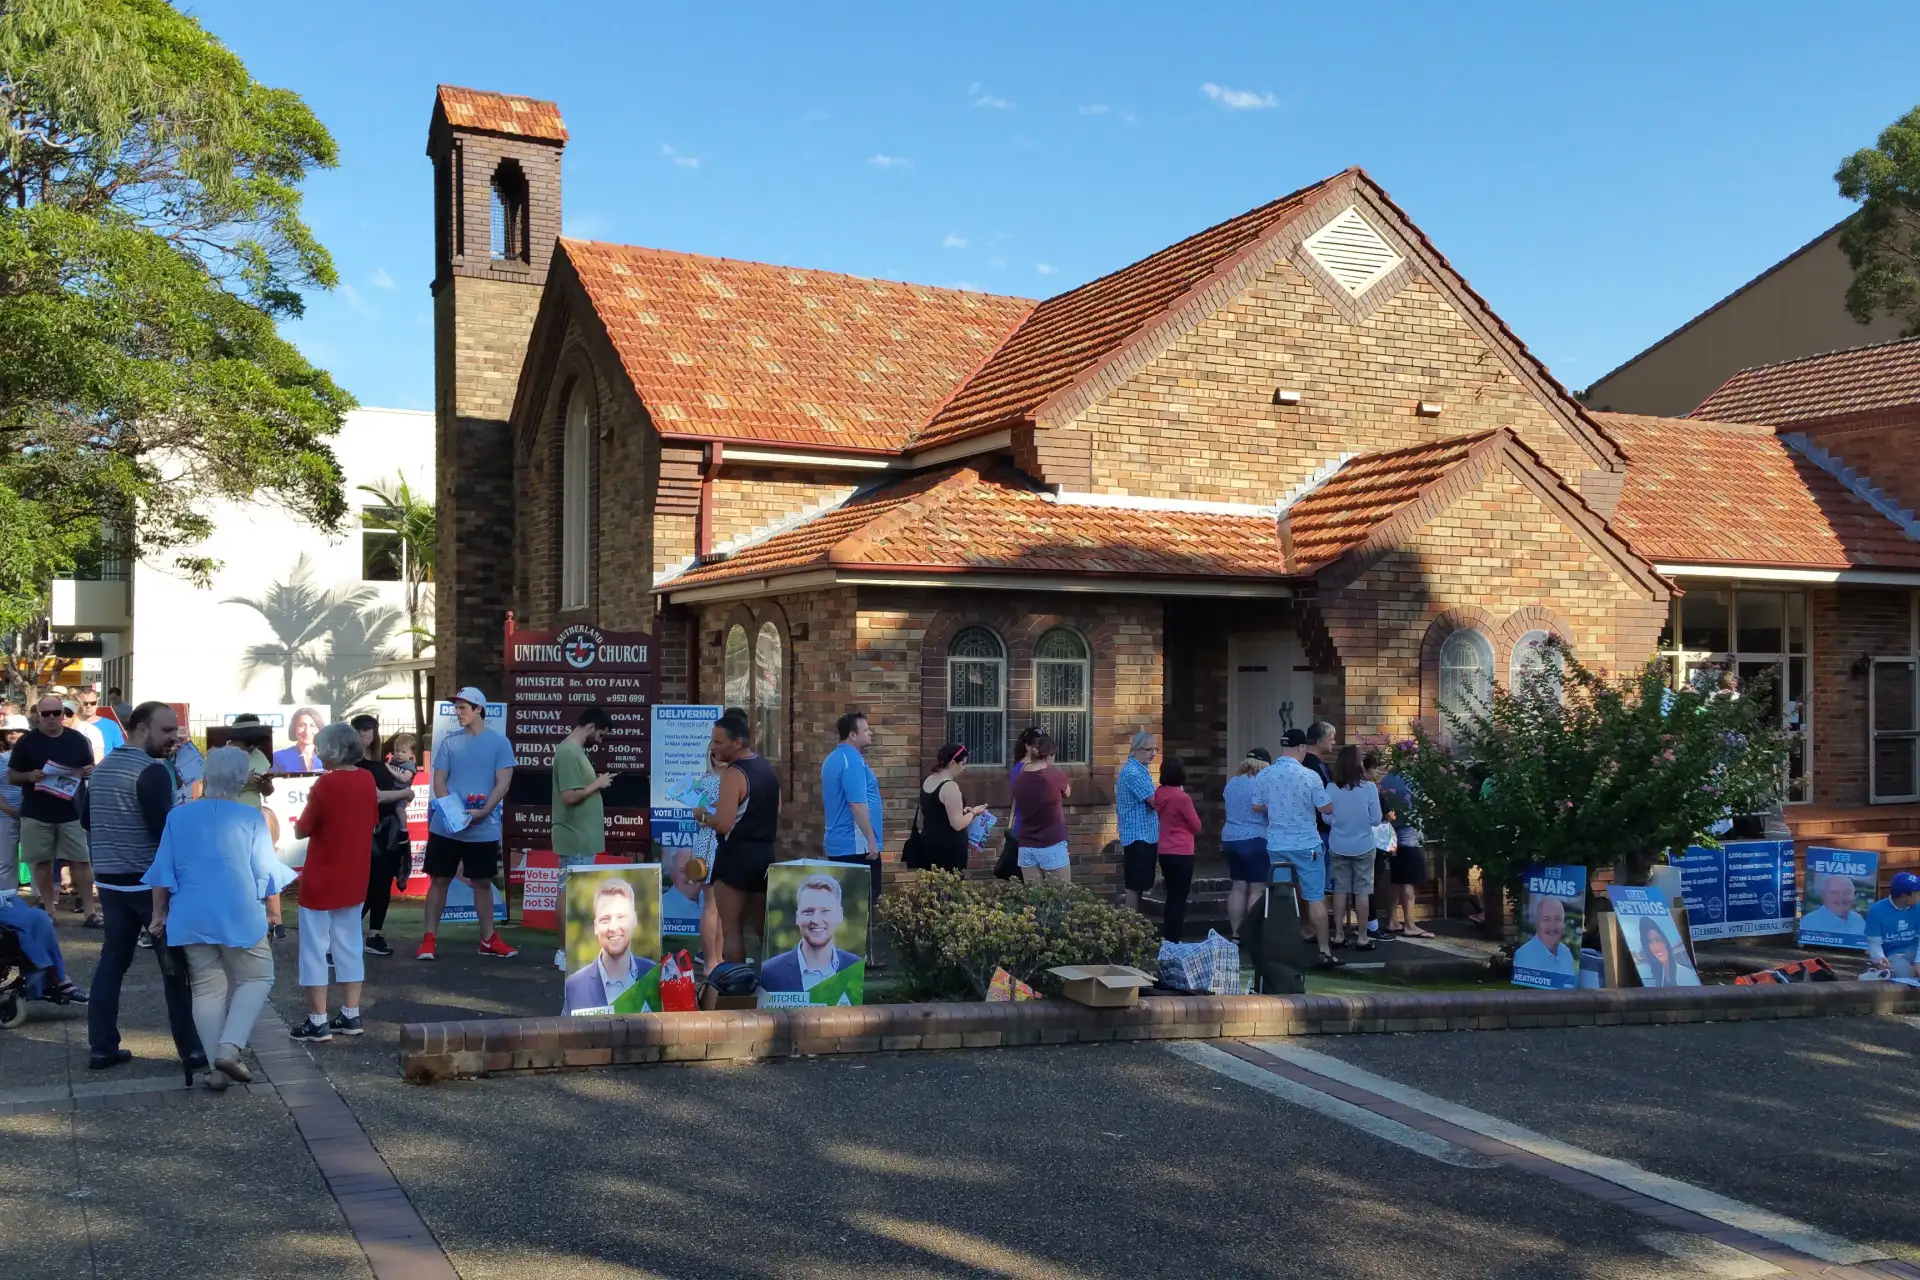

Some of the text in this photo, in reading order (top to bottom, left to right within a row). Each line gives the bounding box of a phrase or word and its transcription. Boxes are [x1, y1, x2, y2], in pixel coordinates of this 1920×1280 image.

[556, 624, 603, 644] SUTHERLAND
[514, 644, 648, 662] UNITING CHURCH
[516, 677, 564, 687] MINISTER
[586, 679, 606, 687] OTO
[610, 679, 640, 687] FAIVA
[516, 693, 562, 701] SUTHERLAND
[568, 694, 596, 702] LOFTUS
[516, 710, 562, 720] SUNDAY
[659, 710, 716, 719] DELIVERING
[516, 725, 572, 735] SERVICES
[516, 743, 557, 753] FRIDAY
[515, 813, 527, 822] We
[528, 813, 543, 822] Are
[614, 815, 644, 825] Church
[1816, 860, 1866, 874] EVANS
[526, 870, 549, 879] Vote
[1547, 868, 1560, 878] LEE
[1530, 878, 1576, 896] EVANS
[1616, 900, 1667, 915] PETINOS
[1754, 923, 1779, 931] LIBERAL
[1801, 935, 1843, 944] HEATHCOTE
[1514, 974, 1551, 986] HEATHCOTE
